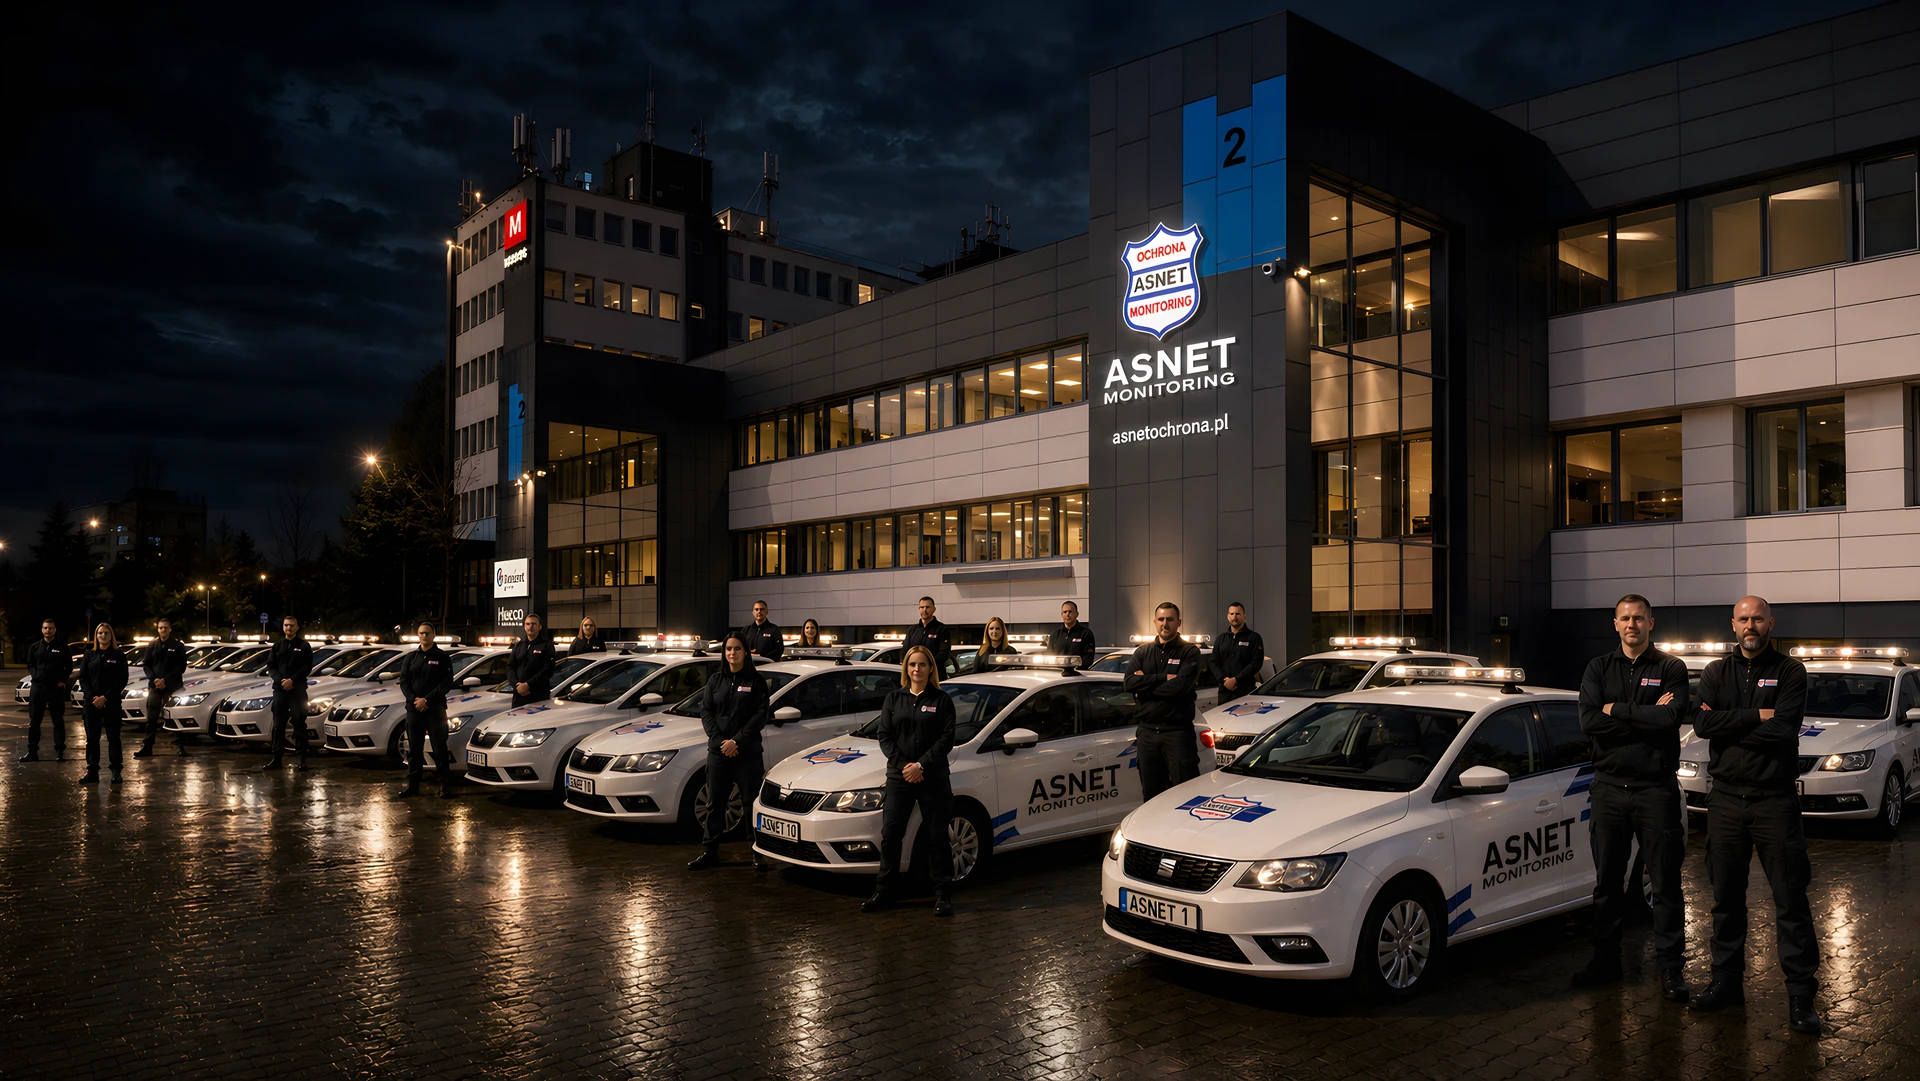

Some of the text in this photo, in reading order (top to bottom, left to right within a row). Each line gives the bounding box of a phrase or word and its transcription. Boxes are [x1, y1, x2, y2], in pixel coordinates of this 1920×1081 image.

[1222, 126, 1247, 168] 2
[509, 210, 522, 238] M
[1136, 241, 1187, 263] OCHRONA
[1133, 266, 1188, 293] ASNET
[1129, 295, 1193, 319] MONITORING
[1104, 336, 1237, 389] ASNET
[1103, 372, 1236, 405] MONITORING
[518, 400, 525, 419] 2
[1112, 413, 1229, 445] asnetochrona.pl
[1028, 764, 1121, 804] ASNET
[1028, 788, 1119, 816] MONITORING
[786, 823, 797, 838] 10
[1482, 816, 1576, 875] ASNET
[1482, 849, 1575, 890] MONITORING
[1130, 894, 1188, 926] ASNET 1
